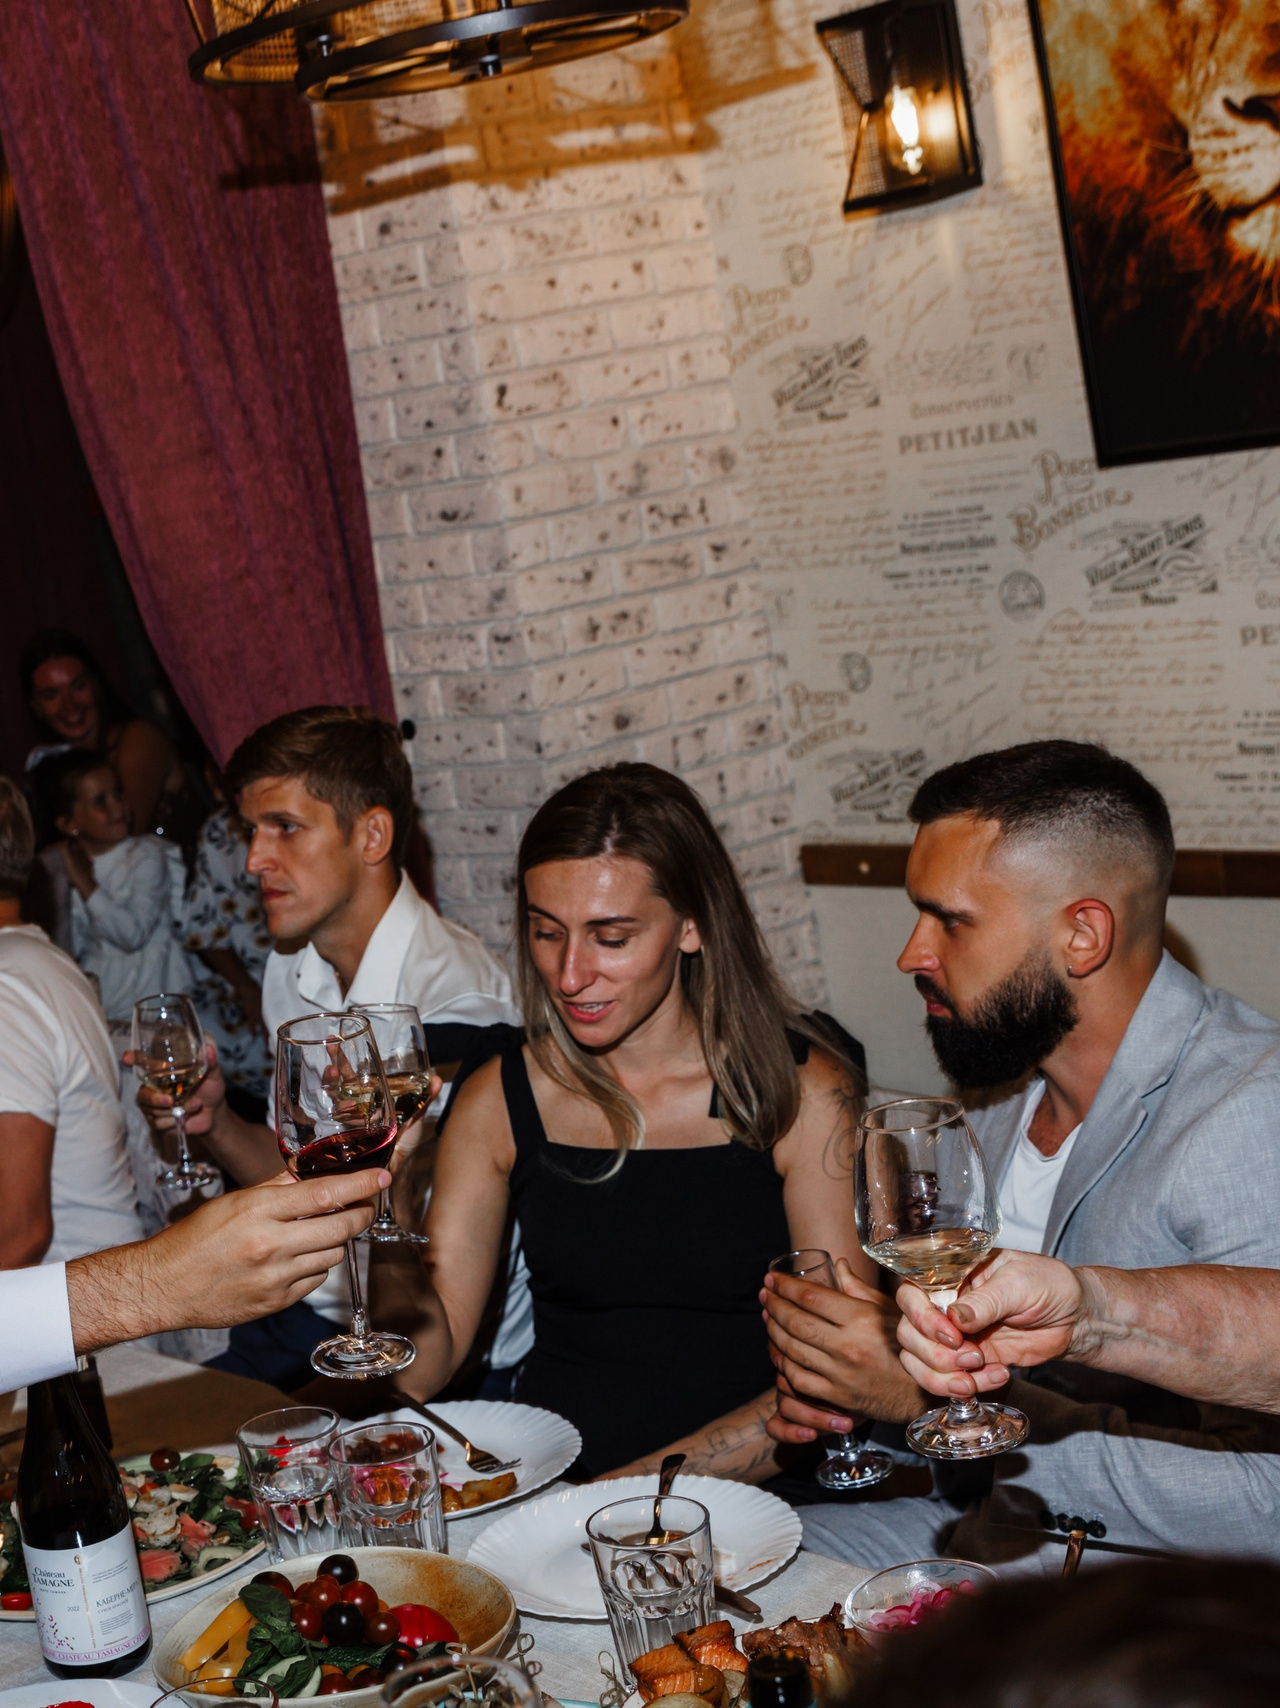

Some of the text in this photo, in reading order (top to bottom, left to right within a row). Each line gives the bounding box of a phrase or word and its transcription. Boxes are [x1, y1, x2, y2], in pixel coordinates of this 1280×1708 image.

[898, 417, 1039, 456] PETITJEAN
[32, 1572, 75, 1588] TAMAGNE
[34, 1566, 66, 1578] Château
